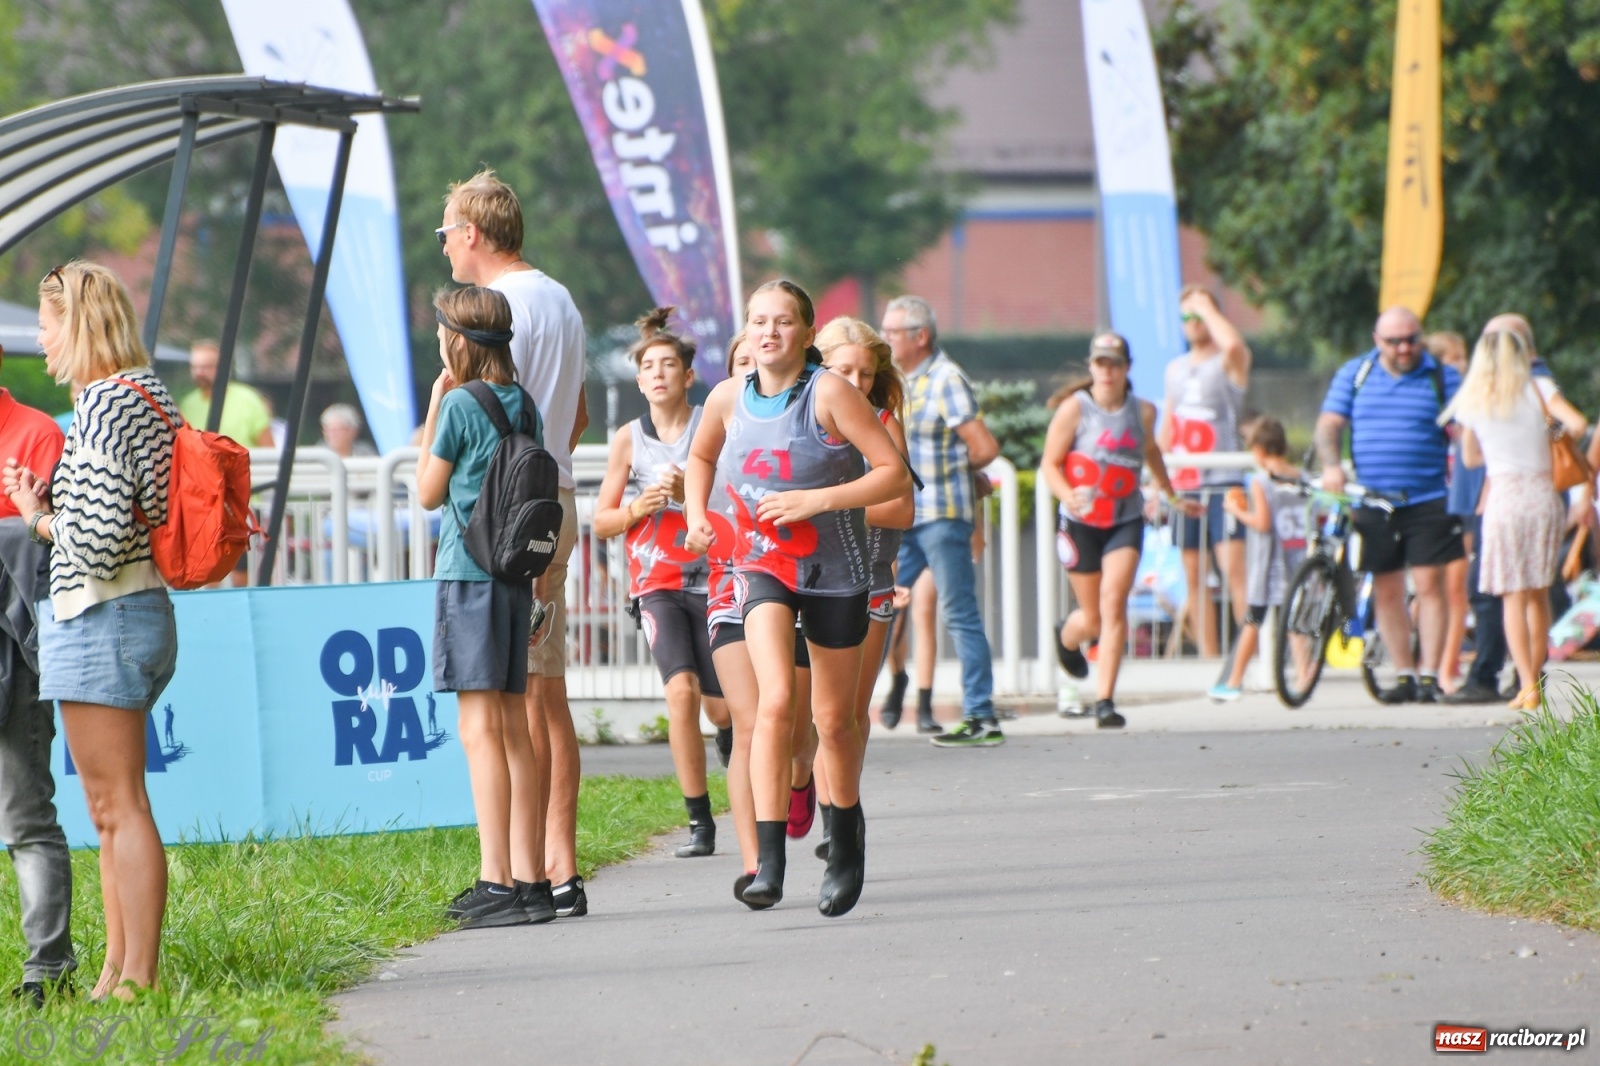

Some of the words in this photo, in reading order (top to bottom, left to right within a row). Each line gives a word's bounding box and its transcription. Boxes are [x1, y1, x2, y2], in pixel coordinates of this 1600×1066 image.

[1096, 427, 1137, 452] 44
[742, 448, 793, 481] 41
[527, 539, 554, 554] PUMA
[319, 626, 426, 697] OD
[357, 678, 398, 713] sup
[367, 769, 393, 782] CUP
